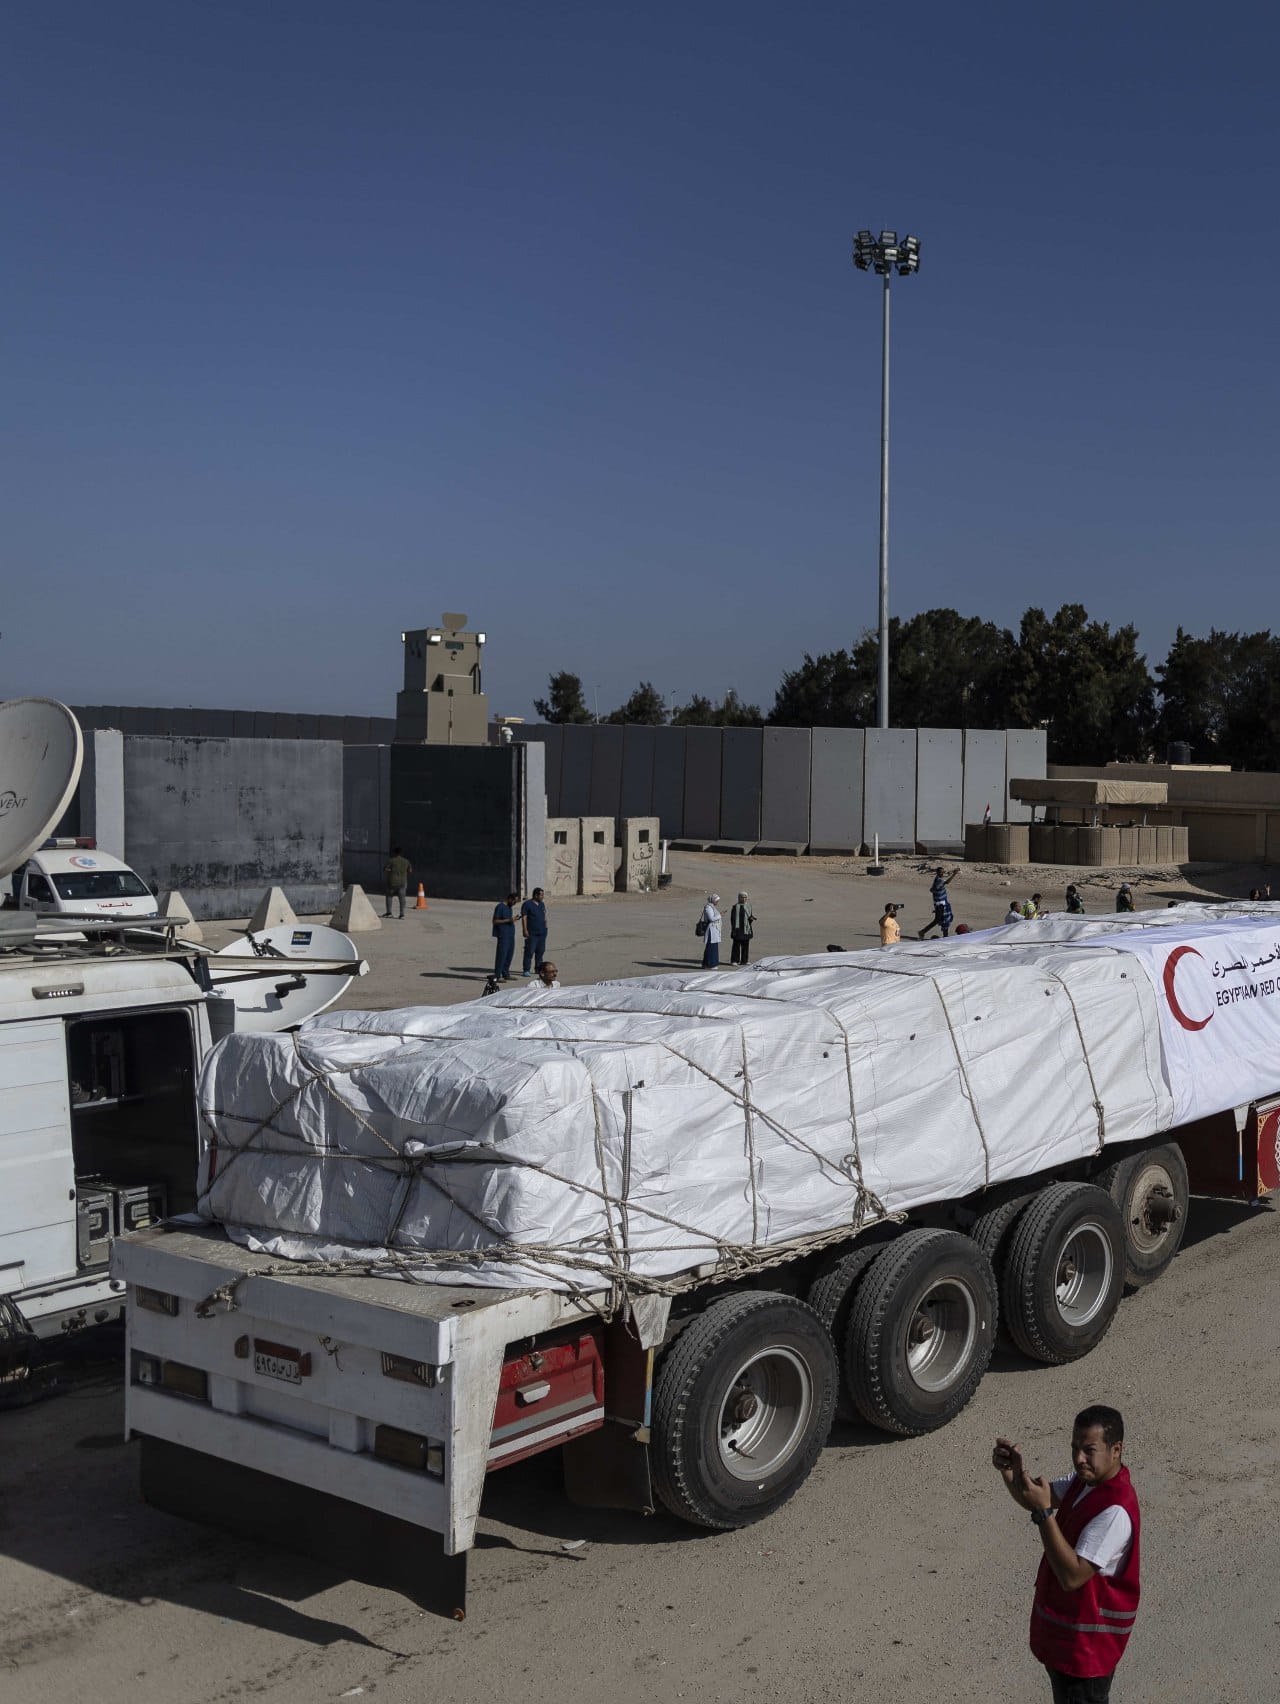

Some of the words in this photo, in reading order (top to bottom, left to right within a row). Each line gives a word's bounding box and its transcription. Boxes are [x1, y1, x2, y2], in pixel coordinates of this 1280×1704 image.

[0, 798, 28, 809] VENT
[632, 843, 653, 861] قف
[1259, 979, 1275, 997] RED
